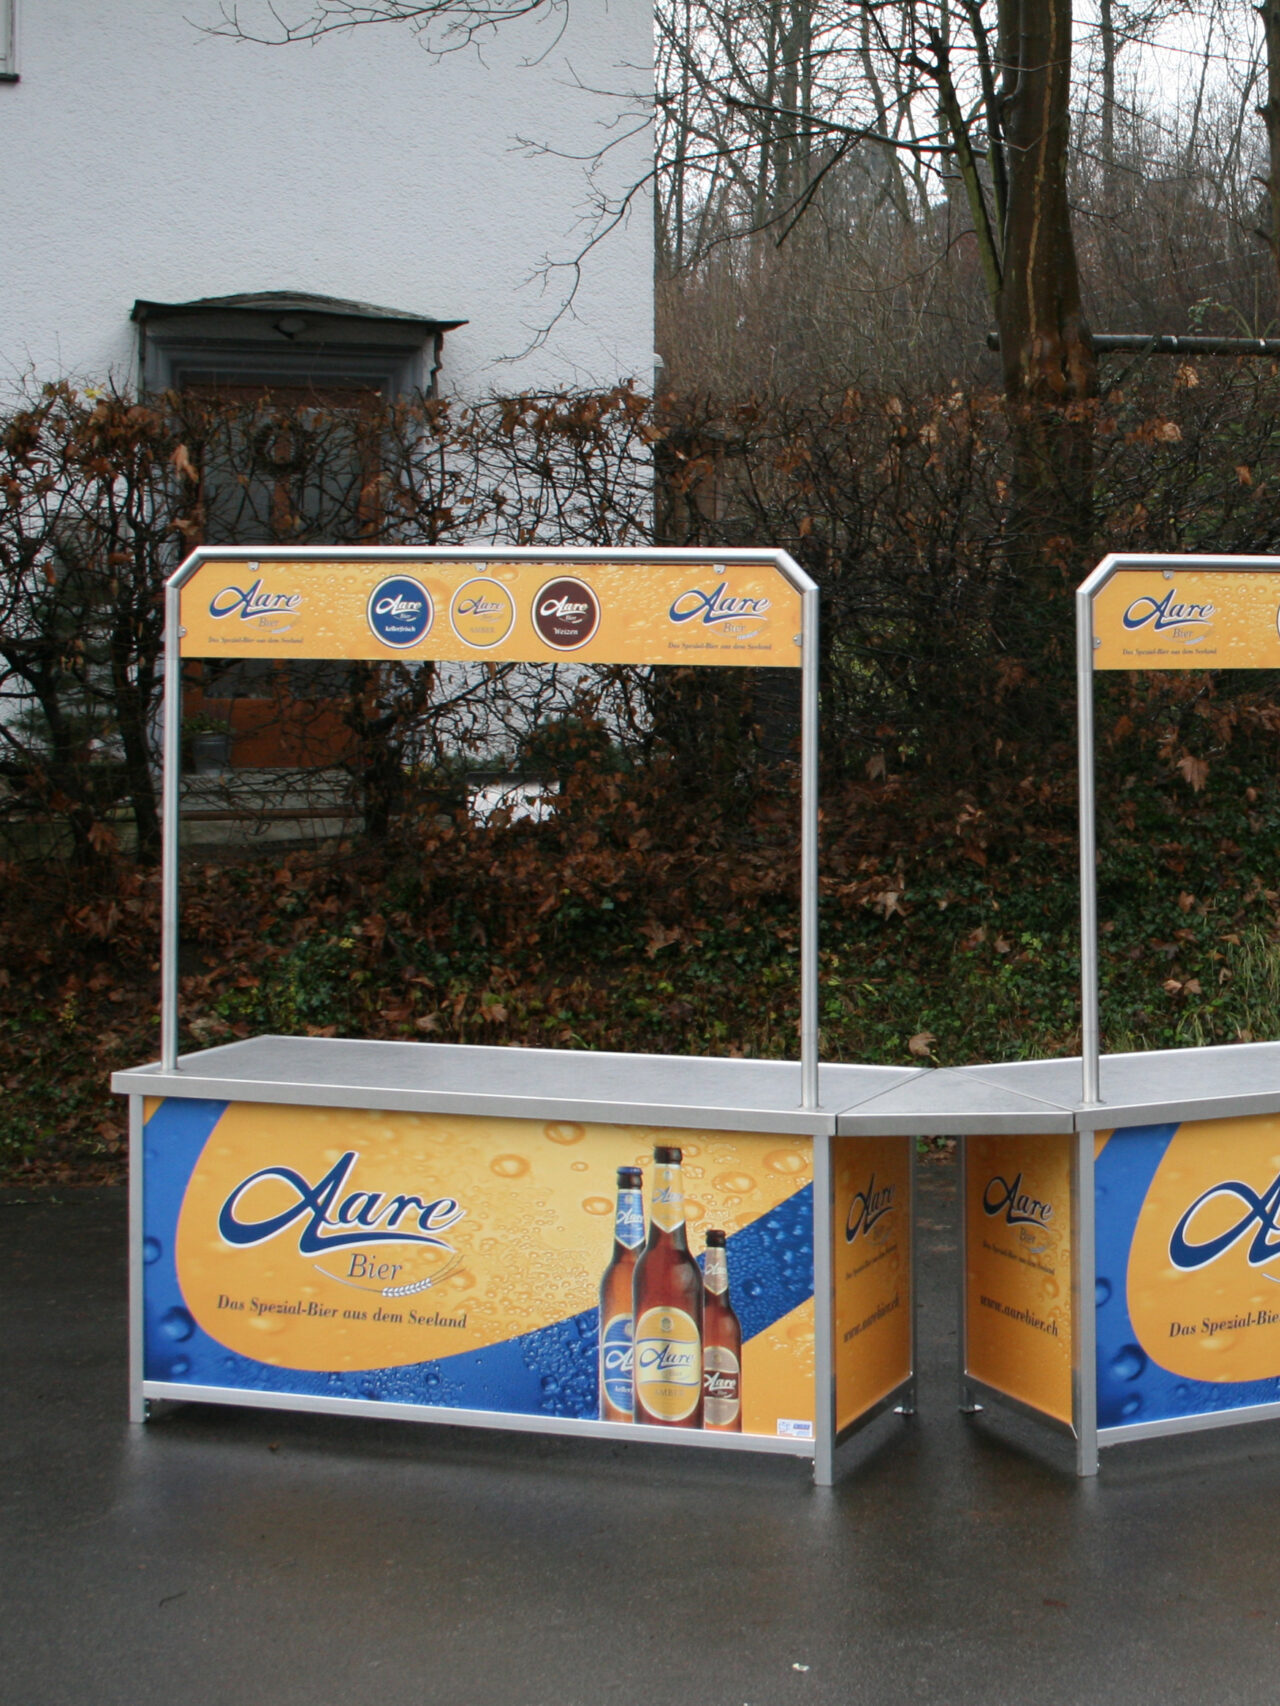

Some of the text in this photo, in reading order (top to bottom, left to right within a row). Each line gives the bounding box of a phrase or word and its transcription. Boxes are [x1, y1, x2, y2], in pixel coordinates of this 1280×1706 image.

[209, 578, 303, 621] Aare
[375, 594, 422, 615] Aare
[457, 595, 505, 616] Aare
[540, 595, 588, 617] Aare
[669, 582, 772, 626] Aare
[1122, 588, 1216, 632] Aare
[553, 627, 579, 635] Weizen
[723, 622, 746, 633] Bier
[1173, 628, 1193, 638] Bier
[217, 1150, 467, 1258] Aare
[983, 1172, 1053, 1231] Aare
[347, 1253, 403, 1281] Bier
[217, 1295, 245, 1311] Das
[343, 1309, 368, 1321] aus
[373, 1307, 403, 1324] dem
[408, 1310, 468, 1329] Seeland
[980, 1294, 1058, 1337] www.aarebier.ch
[1168, 1322, 1196, 1338] Das
[640, 1344, 696, 1370] Aare
